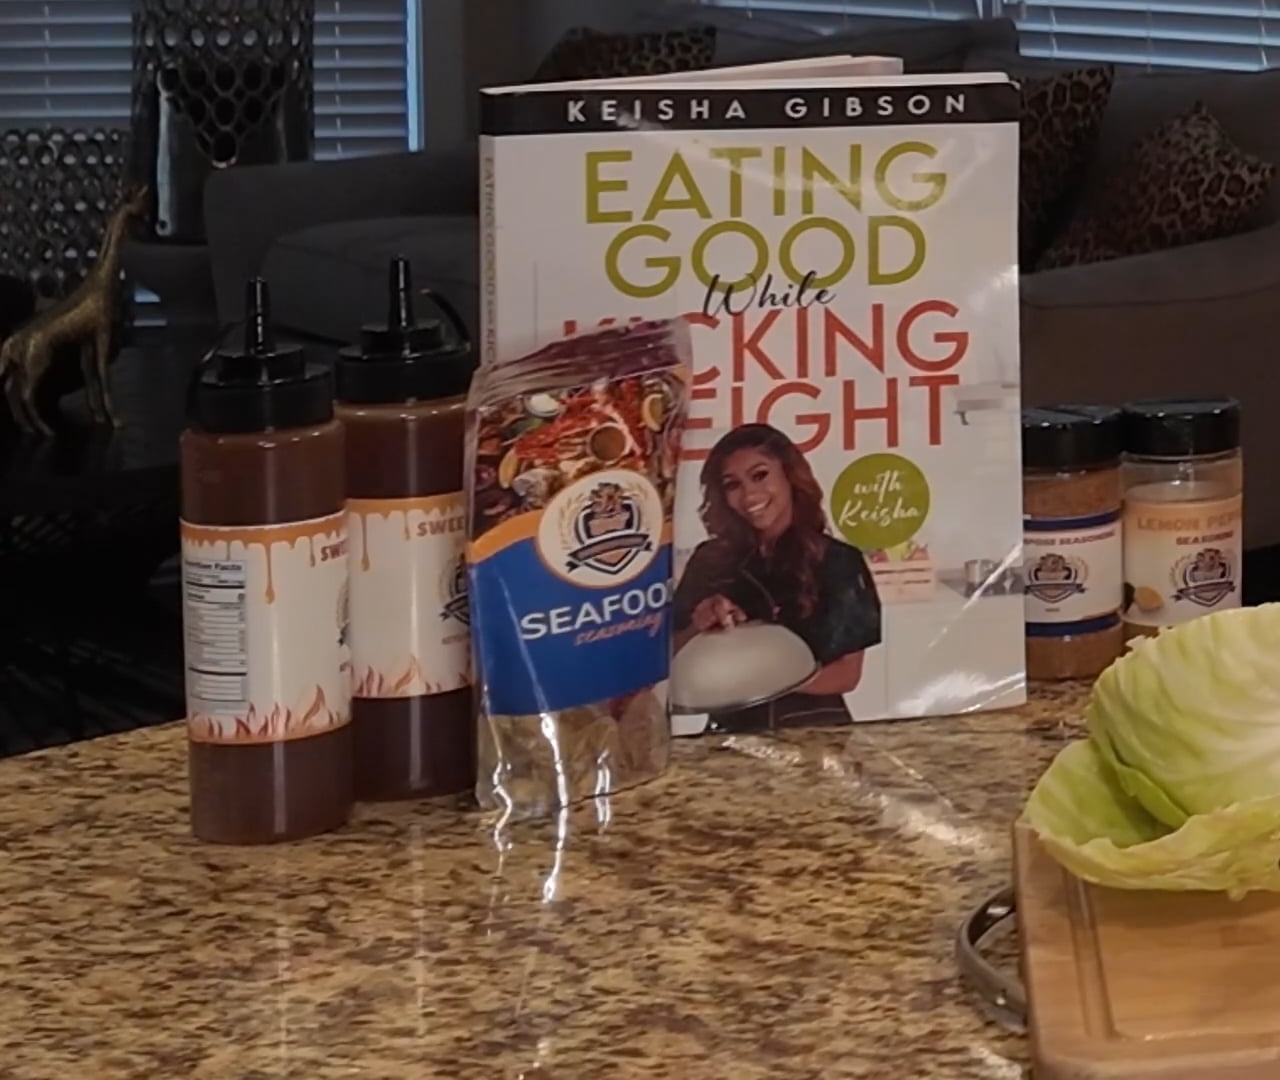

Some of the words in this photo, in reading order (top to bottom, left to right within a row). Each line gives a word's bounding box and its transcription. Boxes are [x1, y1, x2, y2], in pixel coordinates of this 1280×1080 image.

[567, 99, 746, 122] KEISHA
[784, 93, 966, 118] GIBSON
[585, 141, 948, 224] EATING
[604, 215, 927, 298] GOOD
[701, 270, 837, 319] While
[680, 373, 960, 461] EIGHT
[853, 469, 901, 504] with
[838, 497, 920, 528] Keisha
